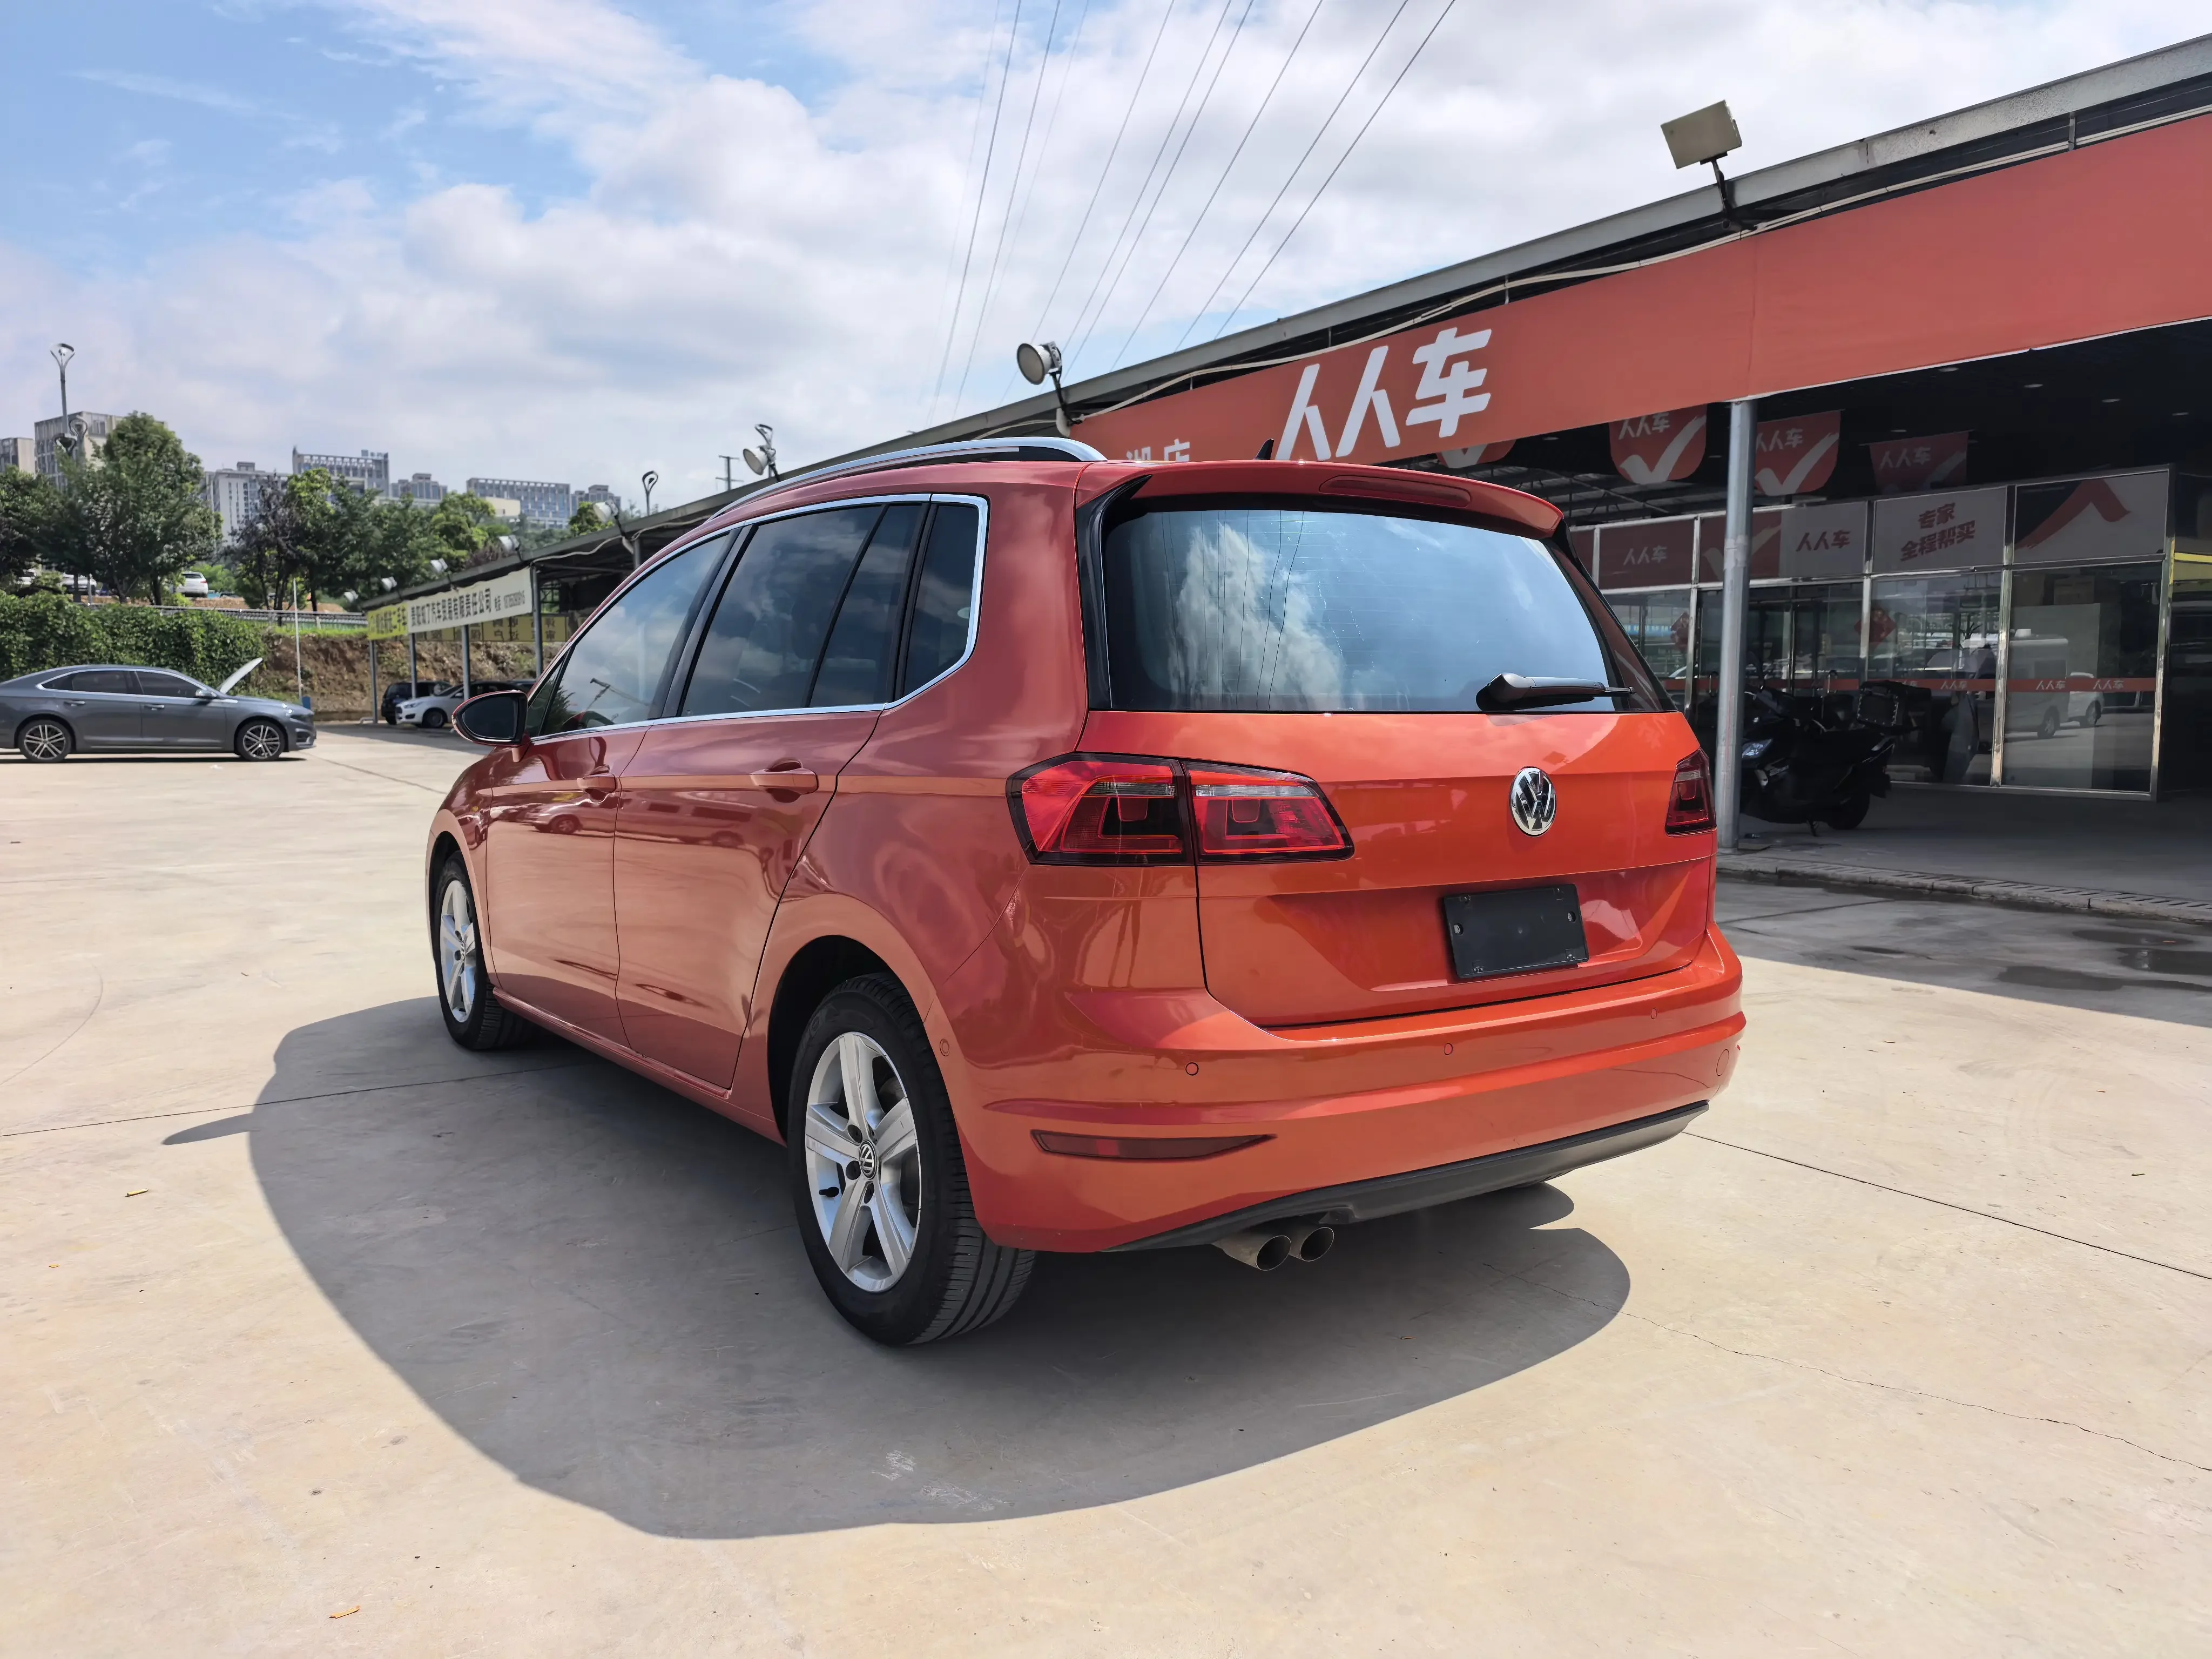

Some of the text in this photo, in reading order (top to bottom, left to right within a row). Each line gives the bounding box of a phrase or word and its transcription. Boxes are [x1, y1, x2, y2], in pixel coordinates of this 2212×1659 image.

[1275, 327, 1492, 461] 人人车
[1618, 412, 1670, 440] 人人车
[1756, 428, 1803, 452] 人人车
[1880, 447, 1931, 469] 人人车
[1918, 503, 1955, 529] 专家
[1796, 529, 1851, 552] 人人车
[1900, 520, 1975, 562] 全程帮买
[1623, 545, 1667, 566] 人人车
[1940, 680, 1967, 689] 人人车
[2035, 680, 2065, 691] 人人车
[2093, 680, 2123, 691] 人人车
[1510, 766, 1556, 837] VW
